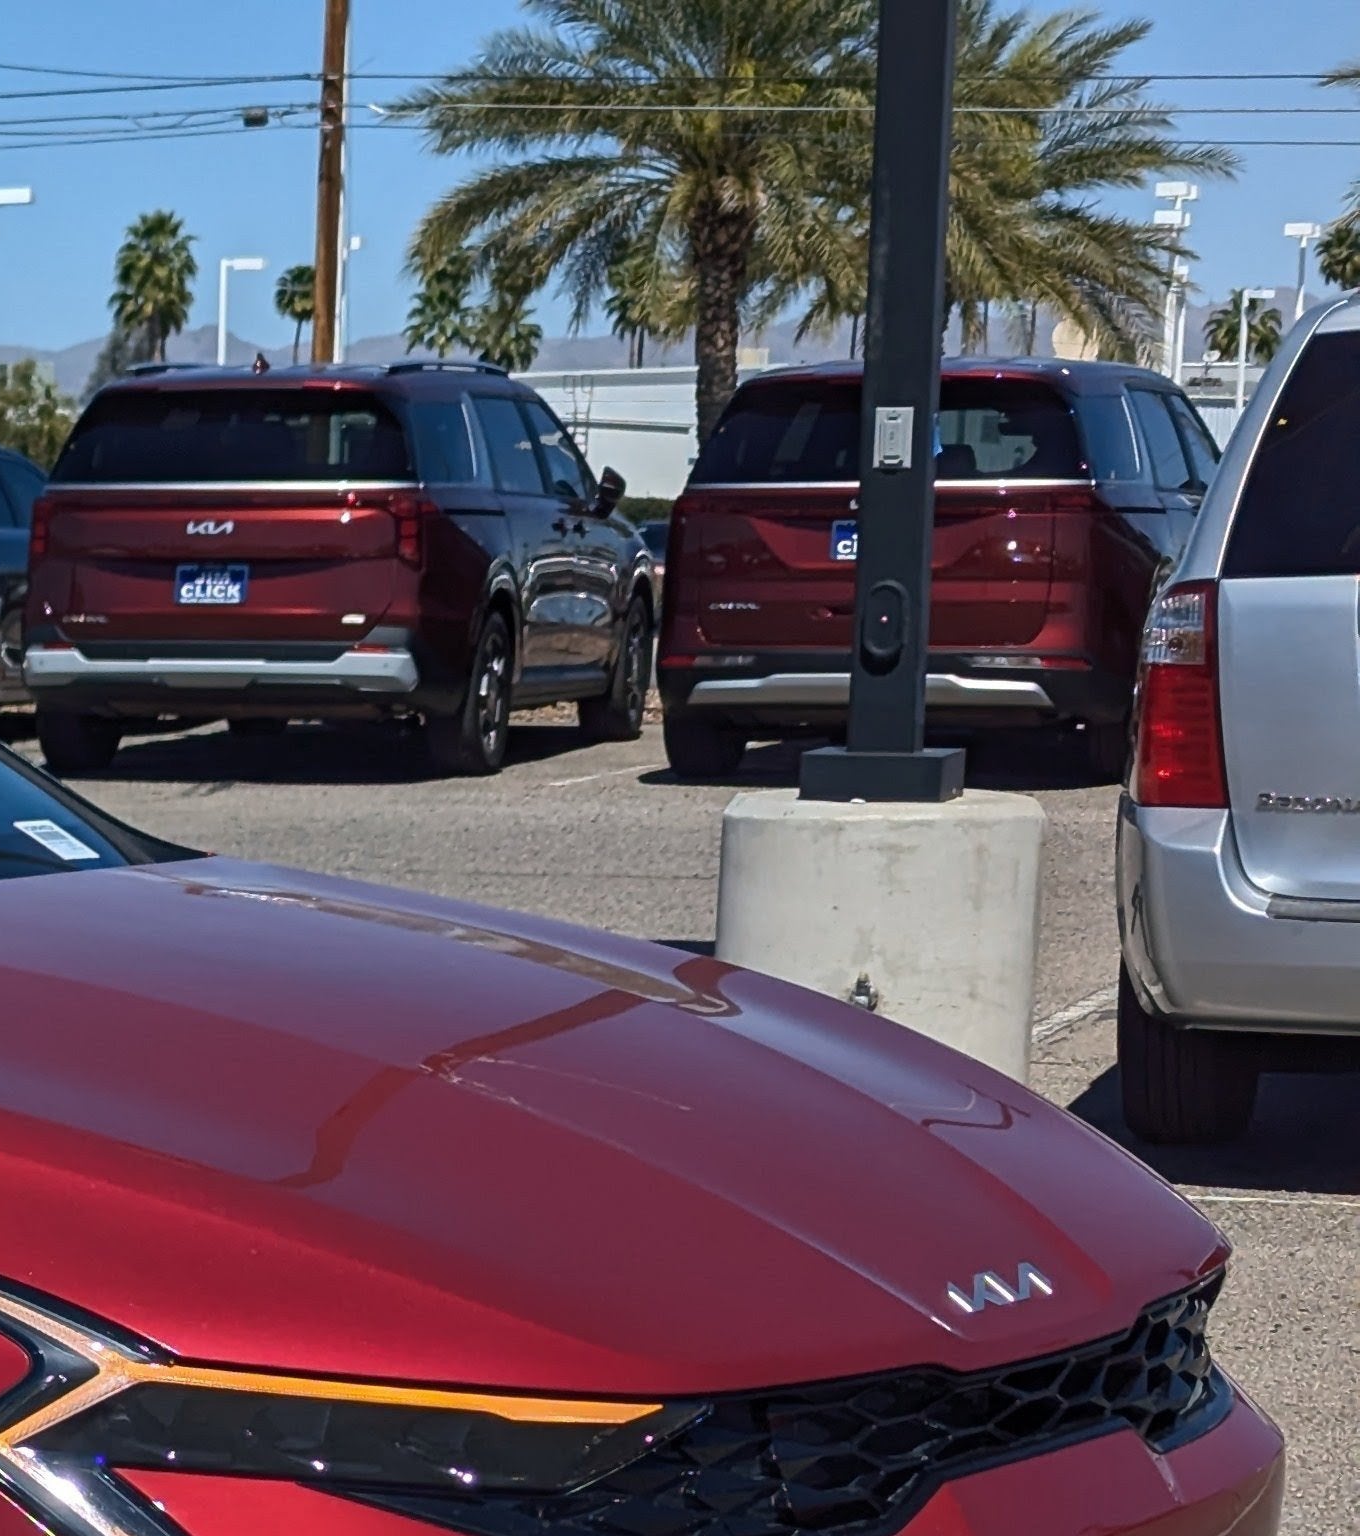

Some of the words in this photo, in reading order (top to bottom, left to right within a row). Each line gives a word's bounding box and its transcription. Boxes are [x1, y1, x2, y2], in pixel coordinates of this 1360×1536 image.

[186, 520, 235, 535] KIA
[180, 582, 241, 598] CLICK
[946, 1262, 1053, 1313] KIA
